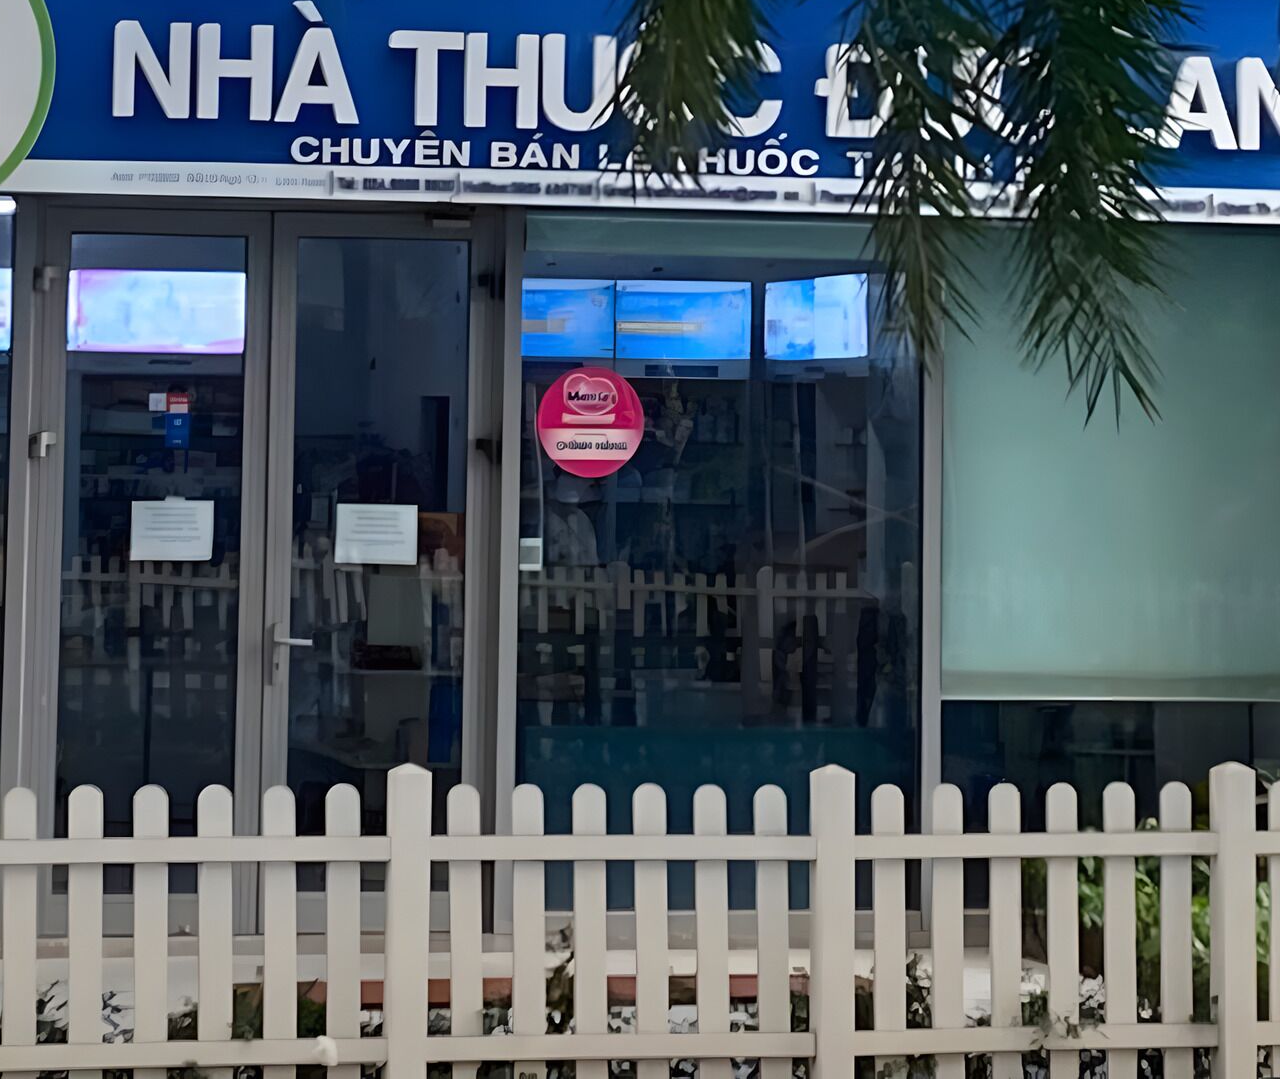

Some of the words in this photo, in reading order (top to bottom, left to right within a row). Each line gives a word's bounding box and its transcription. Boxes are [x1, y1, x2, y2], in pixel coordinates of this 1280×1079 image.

[112, 0, 360, 125] NHÀ
[388, 28, 783, 139] THUC
[290, 130, 470, 167] CHUYÊN
[490, 133, 580, 169] BÁN
